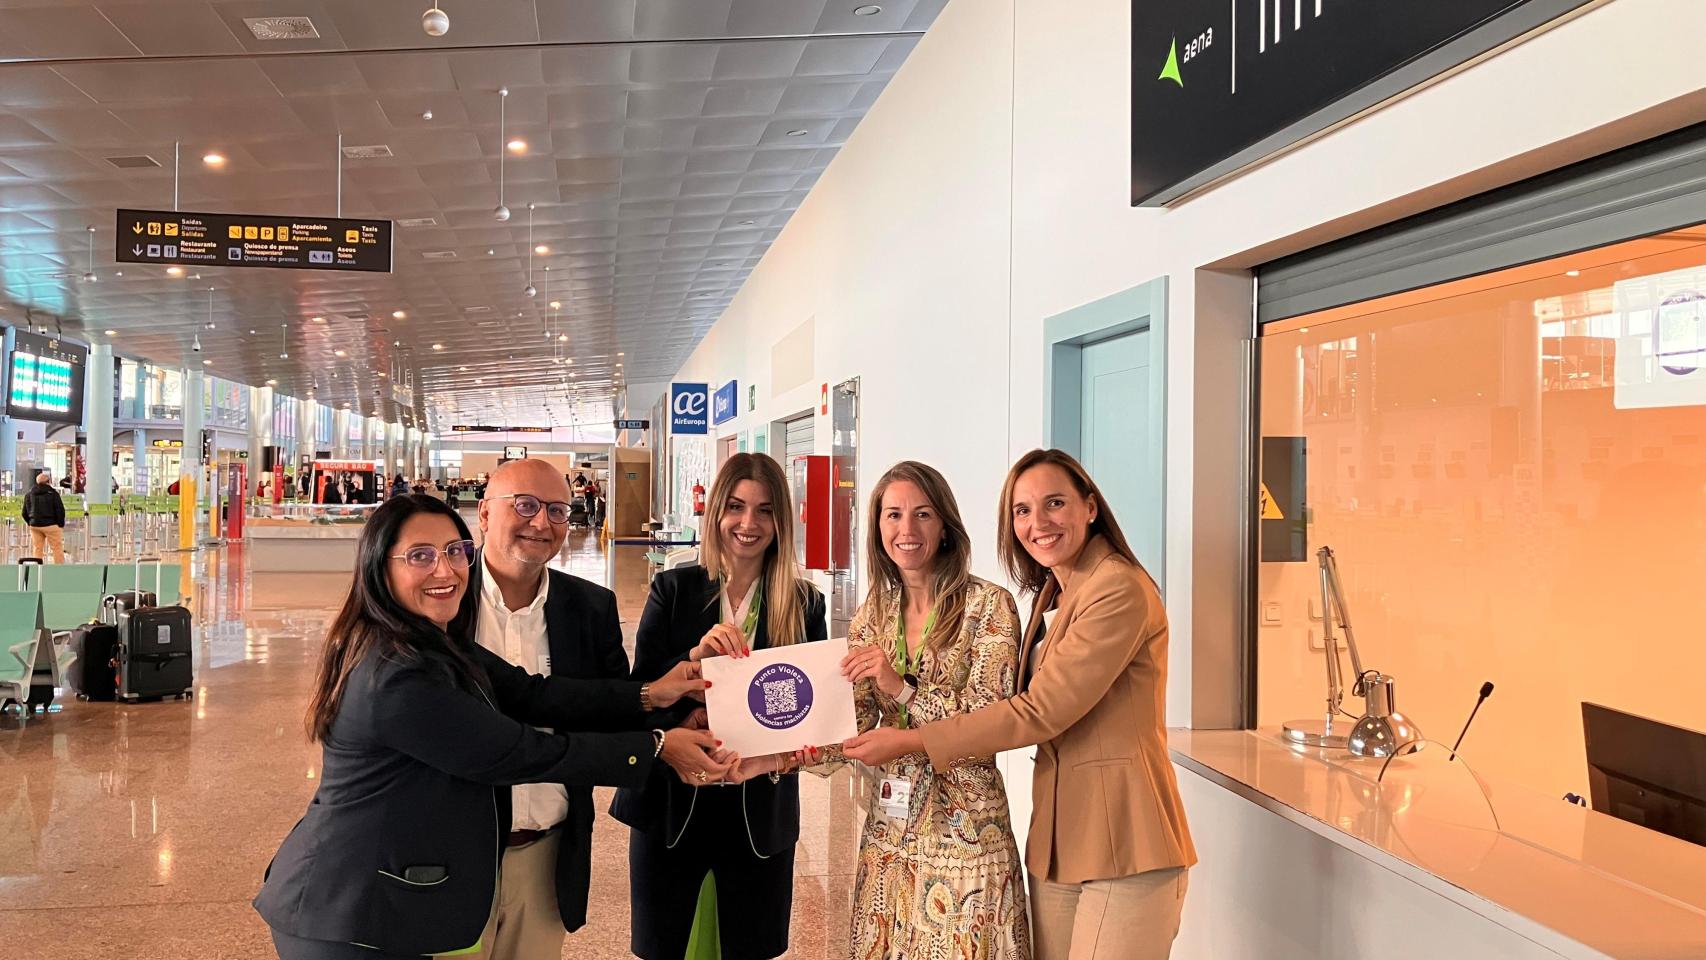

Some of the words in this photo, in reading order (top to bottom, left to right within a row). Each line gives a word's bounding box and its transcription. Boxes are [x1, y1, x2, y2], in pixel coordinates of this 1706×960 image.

[1183, 26, 1213, 64] aena
[180, 240, 217, 248] Restaurante
[674, 418, 706, 426] AirEuropa
[754, 667, 776, 687] Punto
[778, 665, 804, 685] Violeta
[755, 711, 783, 726] violencias
[783, 704, 811, 726] machistas
